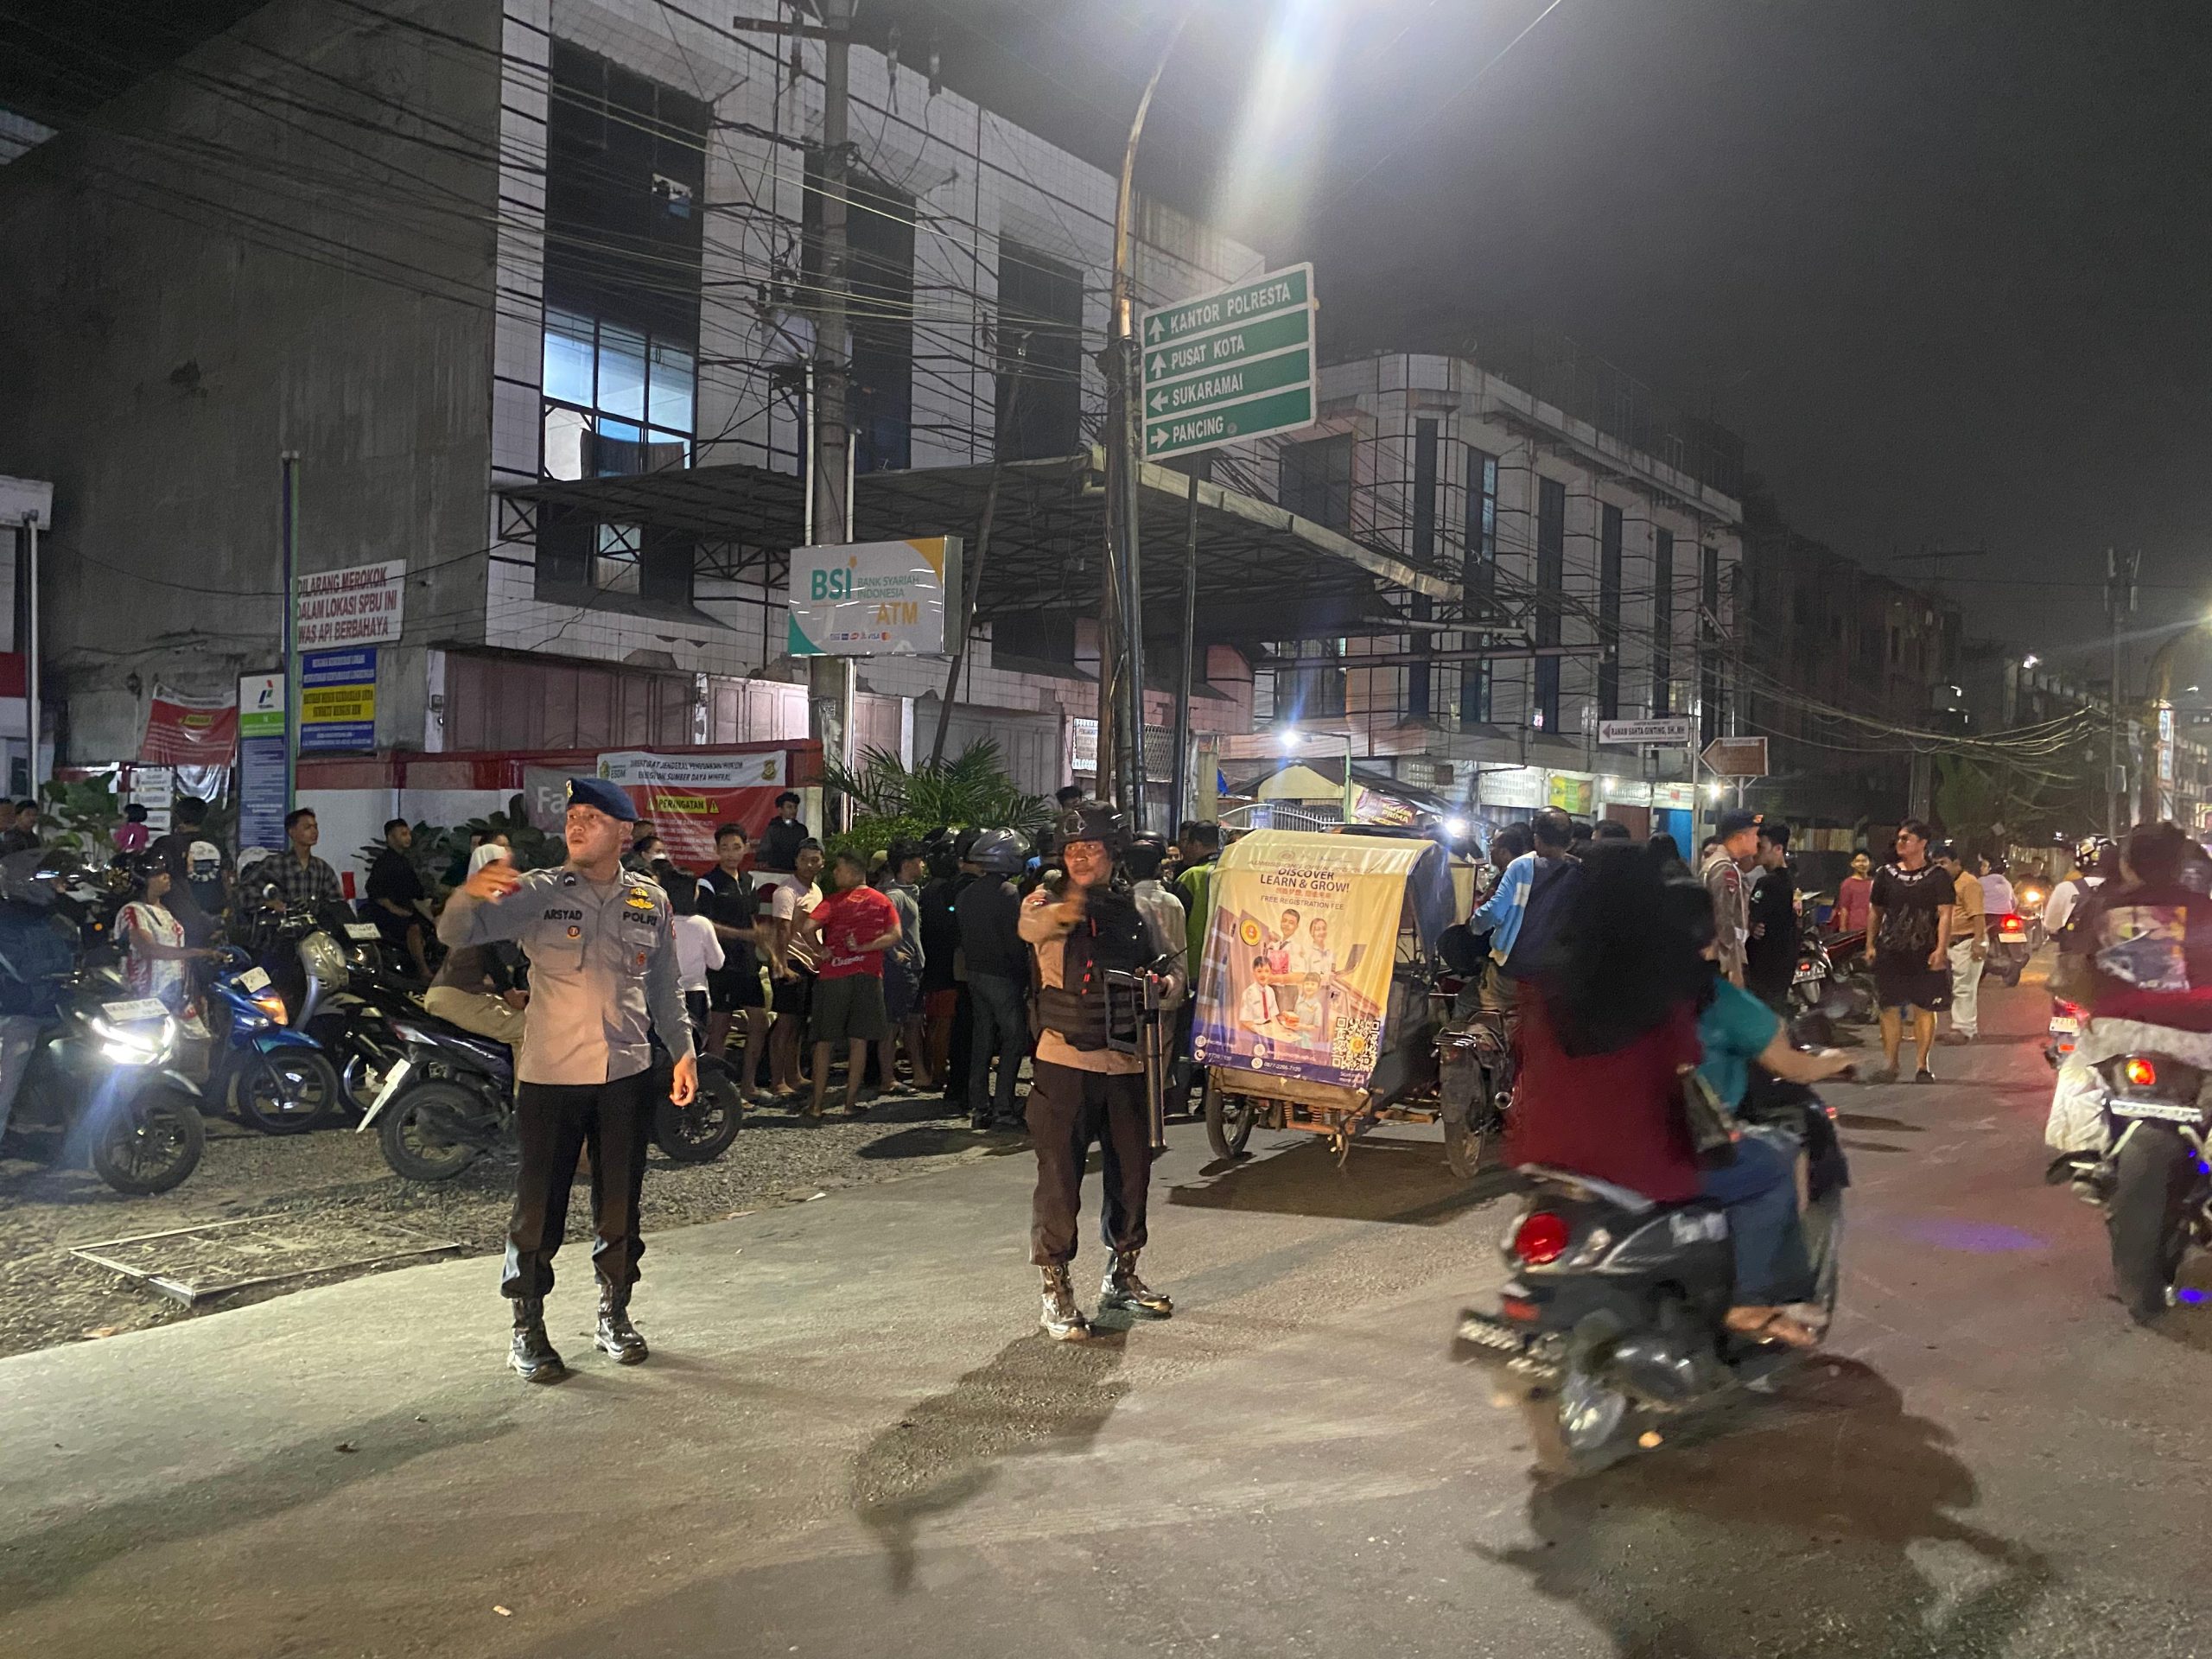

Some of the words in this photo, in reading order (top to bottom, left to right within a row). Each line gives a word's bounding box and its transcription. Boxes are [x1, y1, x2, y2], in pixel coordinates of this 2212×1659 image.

[1171, 305, 1220, 334] KANTOR
[1227, 283, 1291, 317] POLRESTA
[1171, 345, 1206, 370] PUSAT
[1213, 334, 1245, 359] KOTA
[1173, 373, 1243, 406] SUKARAMAI
[1173, 416, 1224, 443] PANCING
[341, 567, 387, 592] MEROKOK
[811, 568, 852, 601] BSI
[857, 577, 881, 588] BANK
[882, 575, 919, 587] SYARIAH
[326, 594, 357, 618] LOKASI
[359, 592, 383, 614] SPBU
[385, 590, 397, 611] INI
[857, 588, 905, 599] INDONESIA
[876, 601, 918, 626] ATM
[297, 624, 317, 645] WAS
[318, 621, 333, 643] API
[334, 616, 389, 640] BERBAHAYA
[658, 799, 704, 810] PERINGATAN
[1382, 809, 1408, 823] PRIMA
[1260, 874, 1296, 887] LEARN
[1299, 879, 1307, 888] &
[1310, 880, 1350, 893] GROW!
[1278, 868, 1335, 880] DISCOVER
[1261, 895, 1279, 904] FREE
[1280, 896, 1329, 909] REGISTRATION
[543, 910, 582, 920] ARSYAD
[623, 912, 658, 926] POLRI
